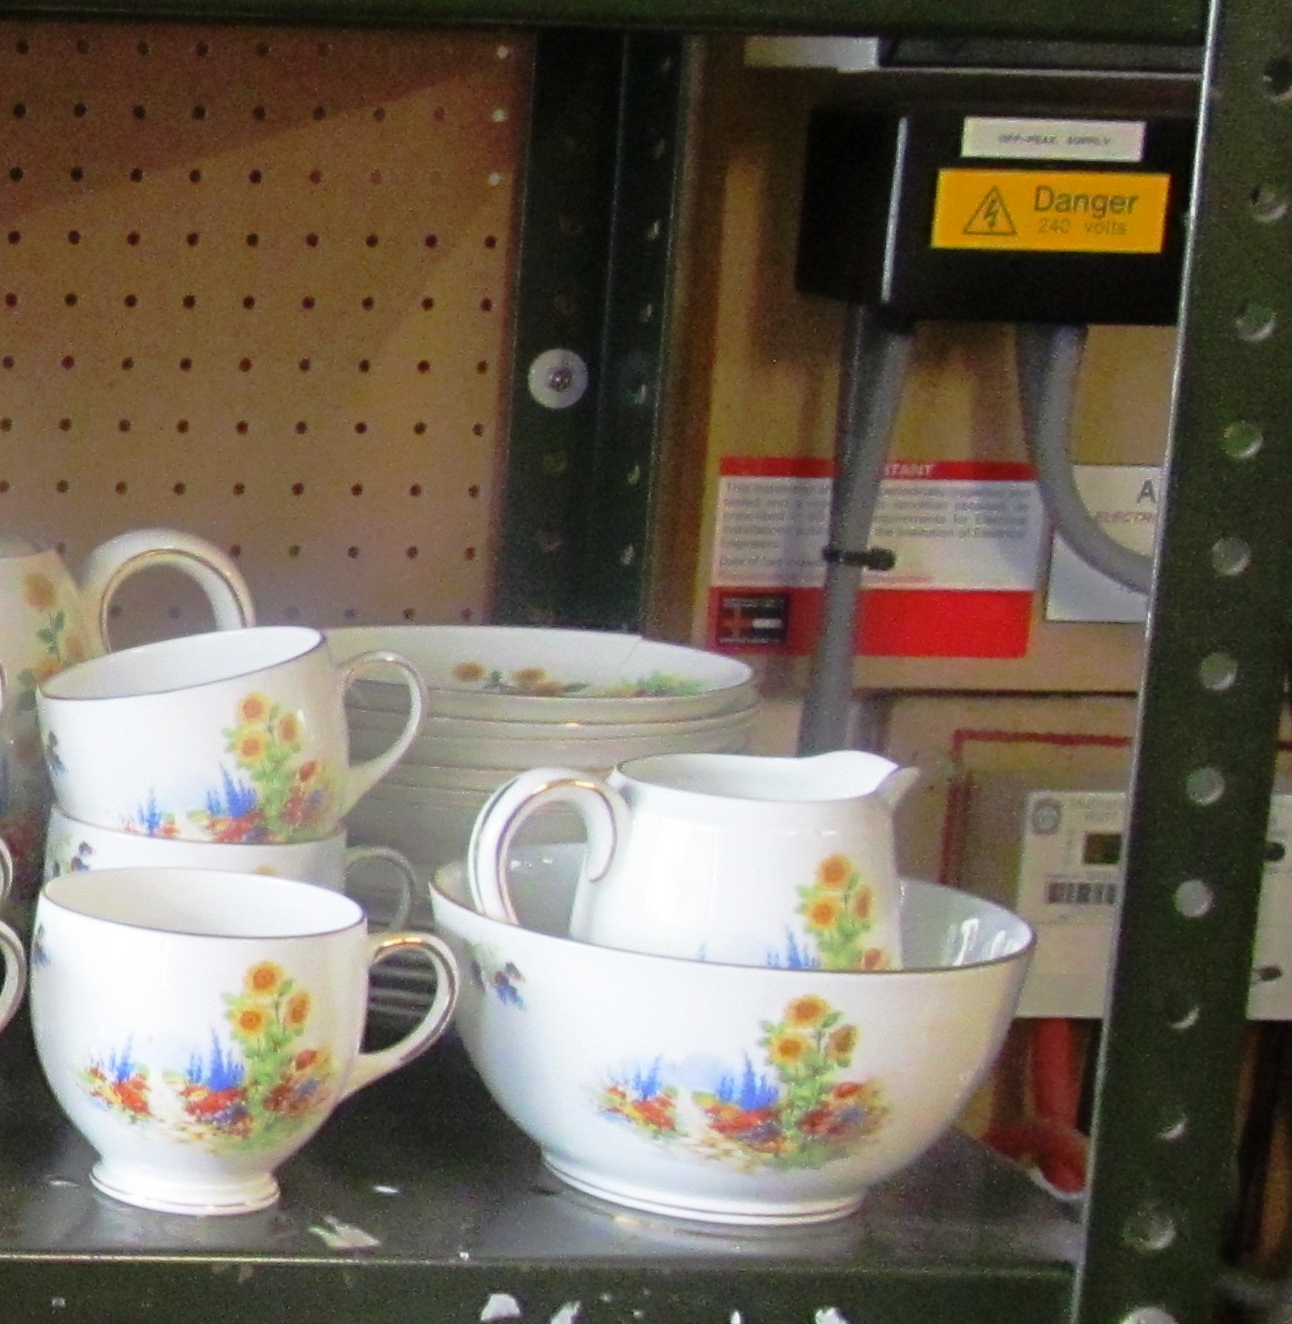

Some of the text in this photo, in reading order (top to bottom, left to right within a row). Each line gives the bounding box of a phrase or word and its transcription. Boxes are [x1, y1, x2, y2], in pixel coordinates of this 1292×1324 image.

[1034, 185, 1139, 219] Danger
[1037, 217, 1128, 236] 240 volts
